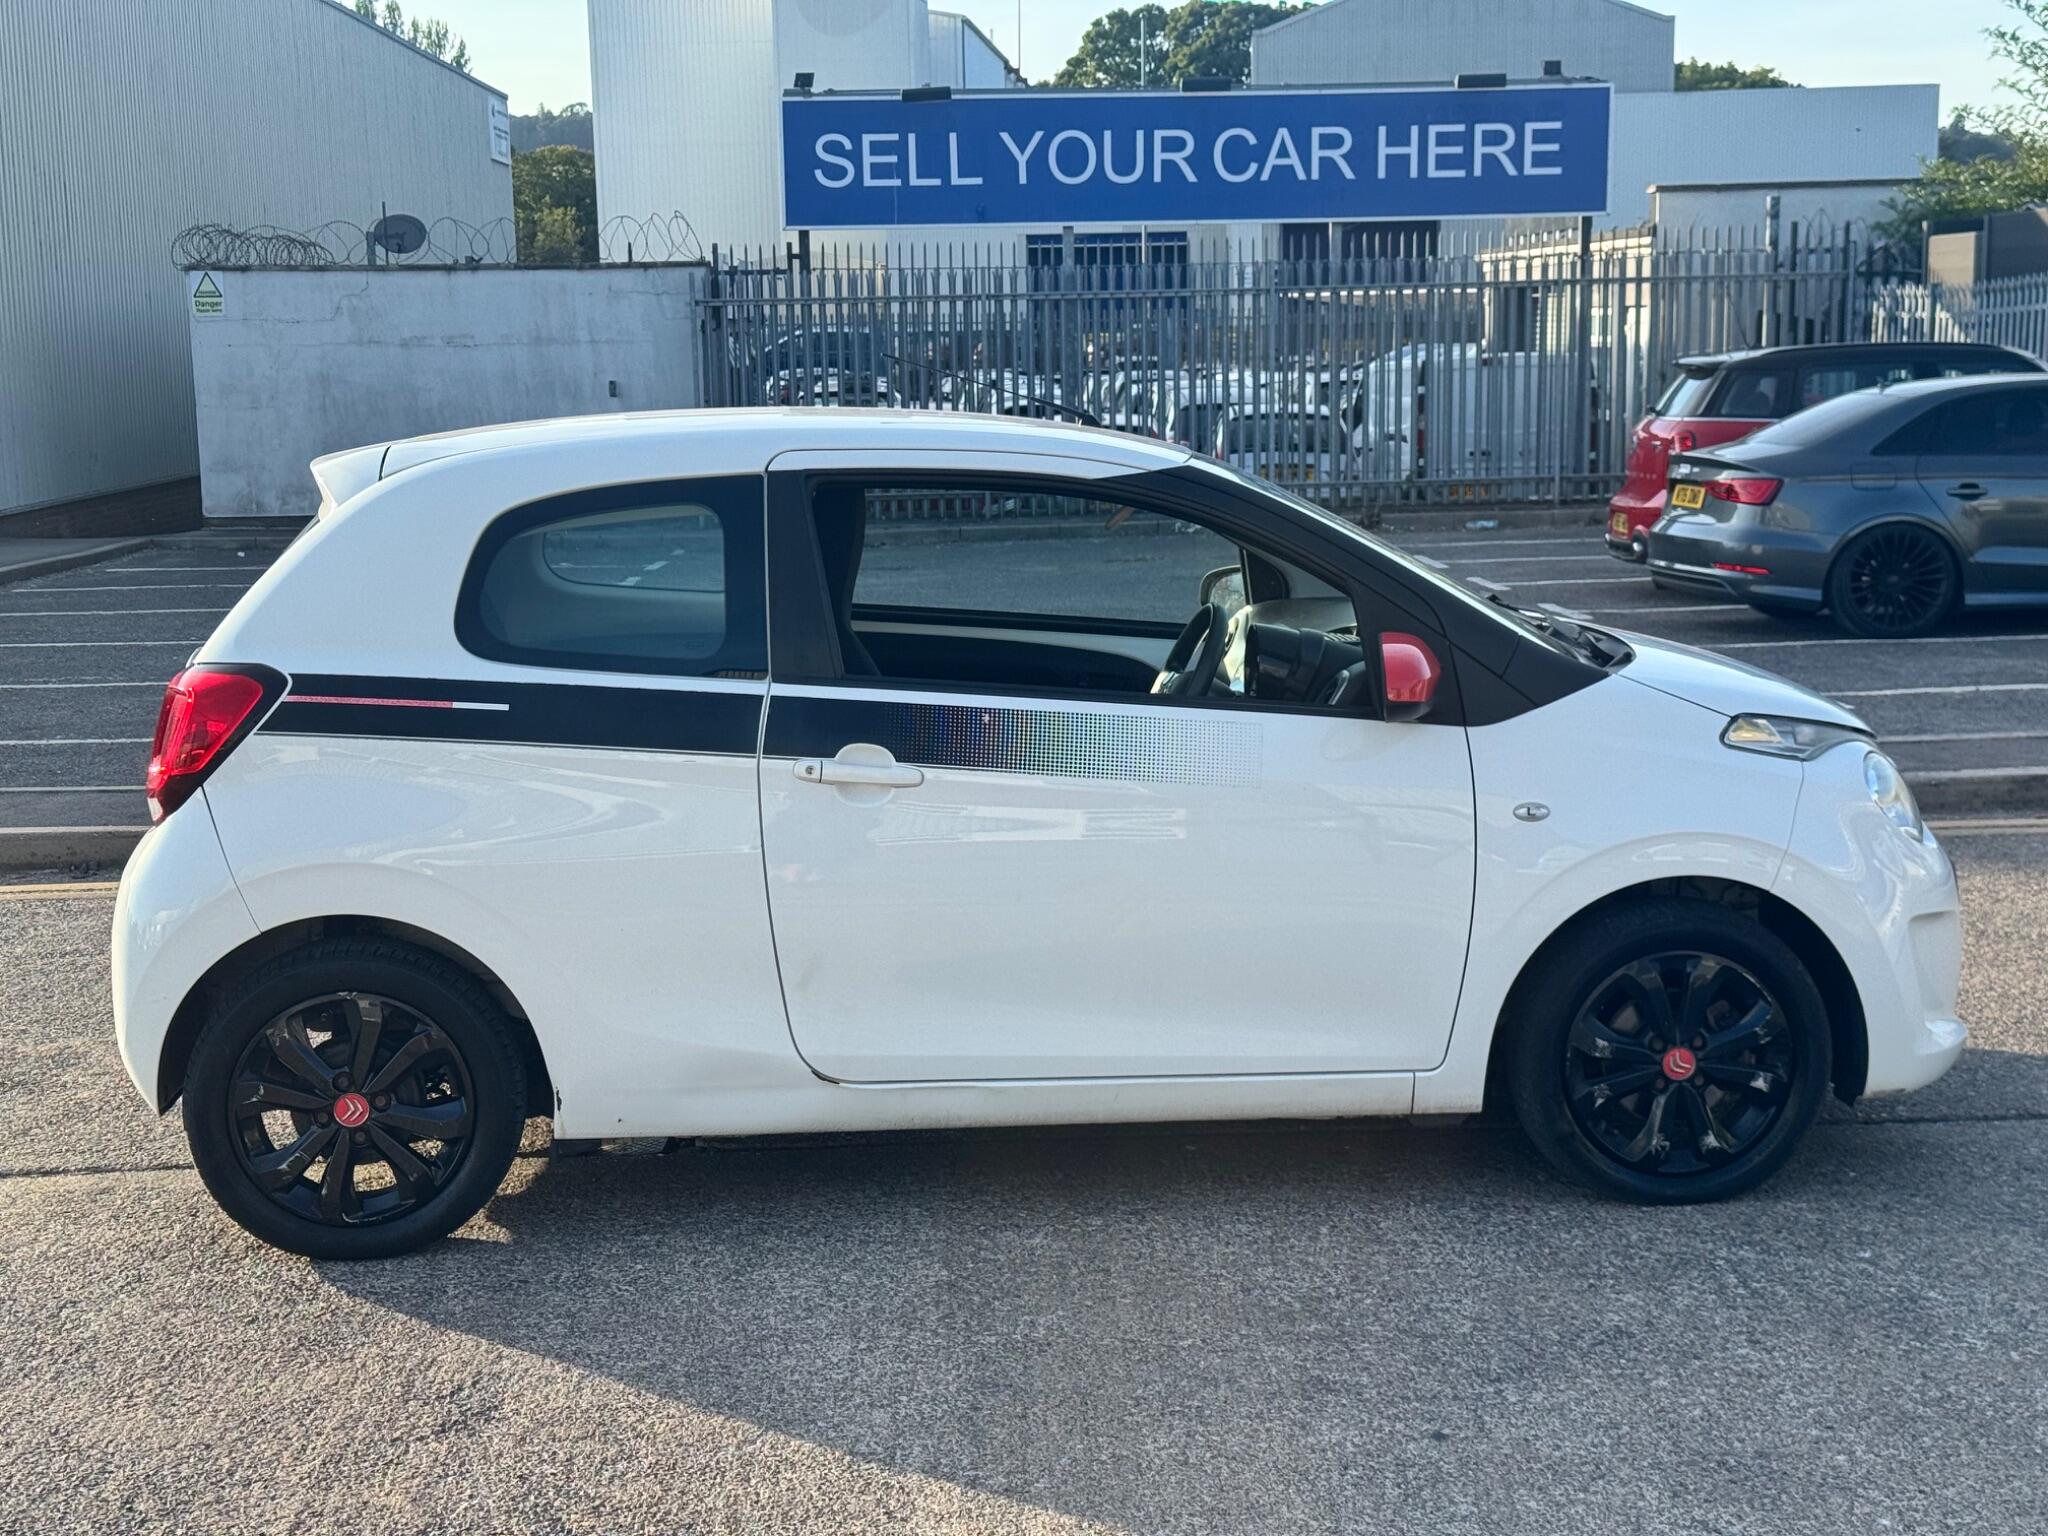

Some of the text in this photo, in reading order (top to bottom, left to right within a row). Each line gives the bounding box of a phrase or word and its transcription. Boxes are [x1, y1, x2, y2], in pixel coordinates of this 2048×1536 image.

[813, 121, 1563, 189] SELL YOUR CAR HERE
[195, 300, 222, 308] Danger
